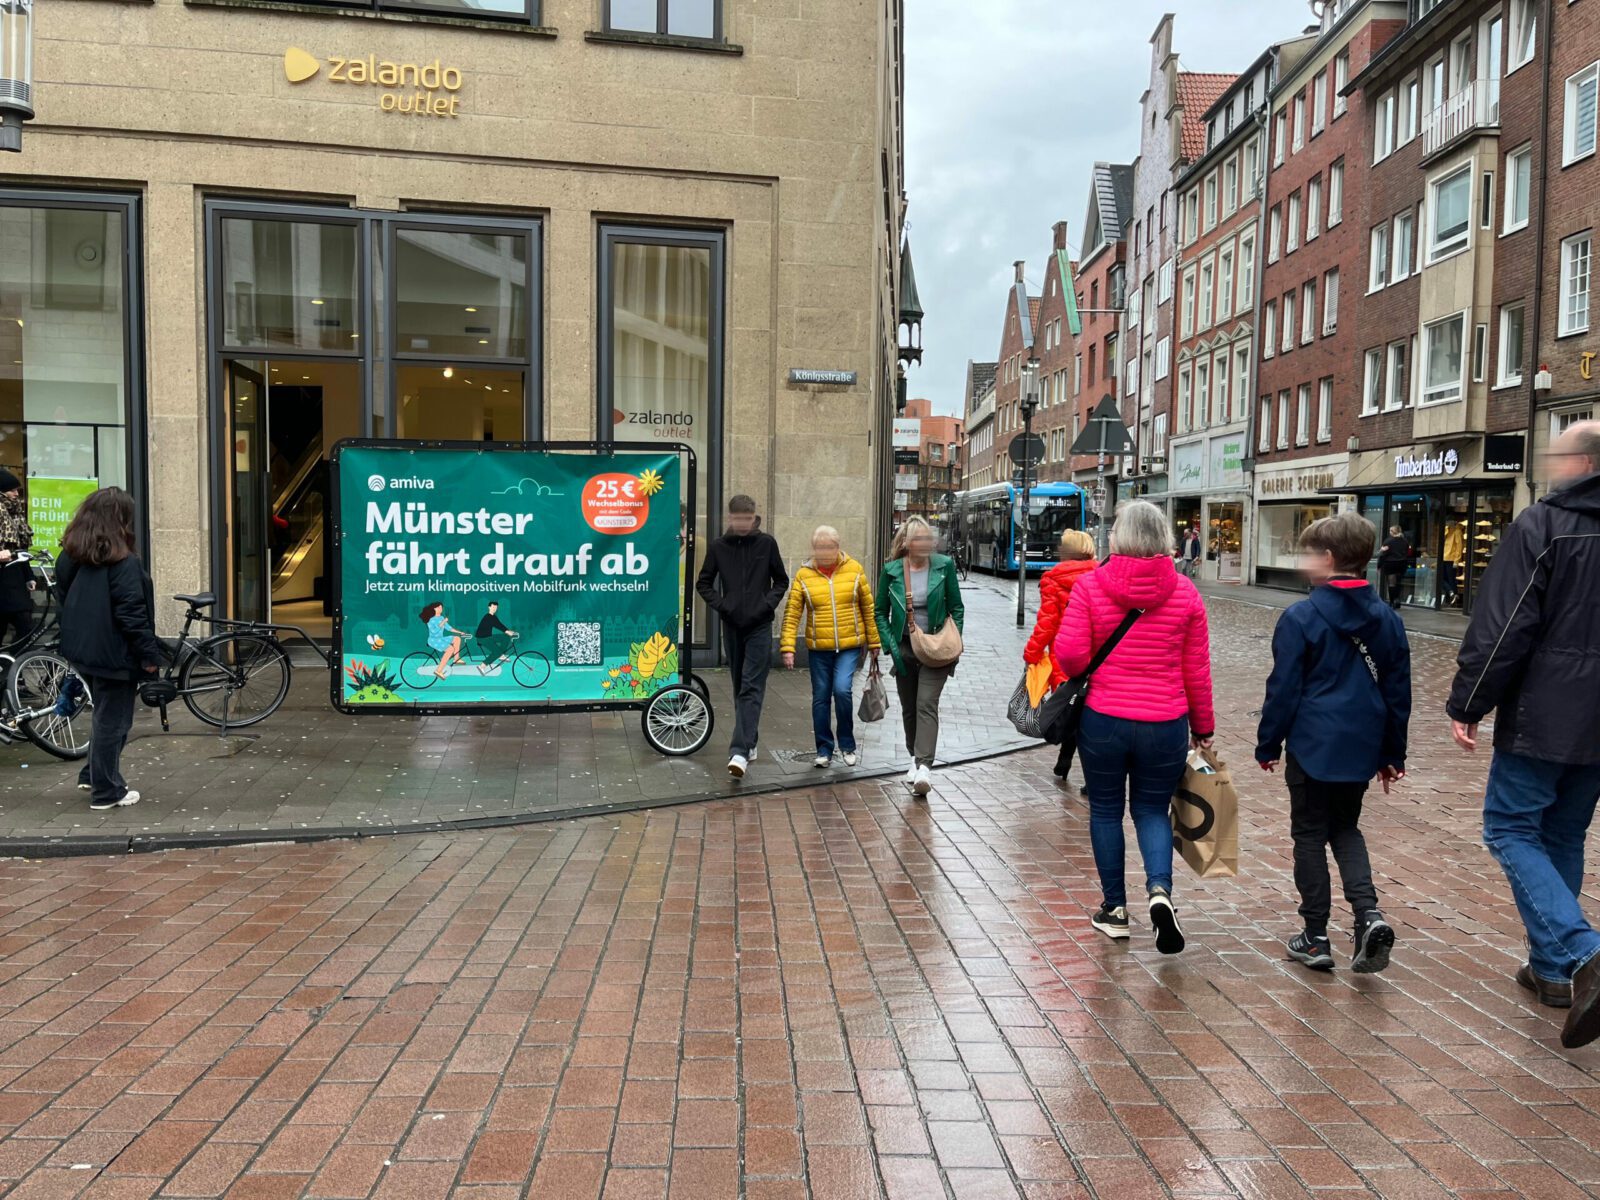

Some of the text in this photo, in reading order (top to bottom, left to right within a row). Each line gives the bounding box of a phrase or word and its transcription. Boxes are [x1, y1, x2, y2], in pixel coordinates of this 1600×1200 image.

[328, 53, 462, 92] zalando
[380, 91, 460, 118] outlet
[795, 370, 852, 382] Königsstraße
[629, 409, 693, 426] zalando
[653, 426, 693, 439] outlet
[1394, 450, 1443, 478] Timberland
[1487, 462, 1514, 471] Timberland
[390, 475, 435, 490] amiva
[596, 480, 636, 498] 25 €
[1261, 477, 1293, 494] GALERIE
[32, 497, 62, 508] DEIN
[588, 499, 644, 507] Wechselbonus
[365, 501, 534, 535] Münster
[32, 523, 56, 537] liegt
[365, 541, 650, 576] fährt drauf ab
[365, 579, 649, 595] Jetzt zum klimapositiven Mobilfunk wechseln!
